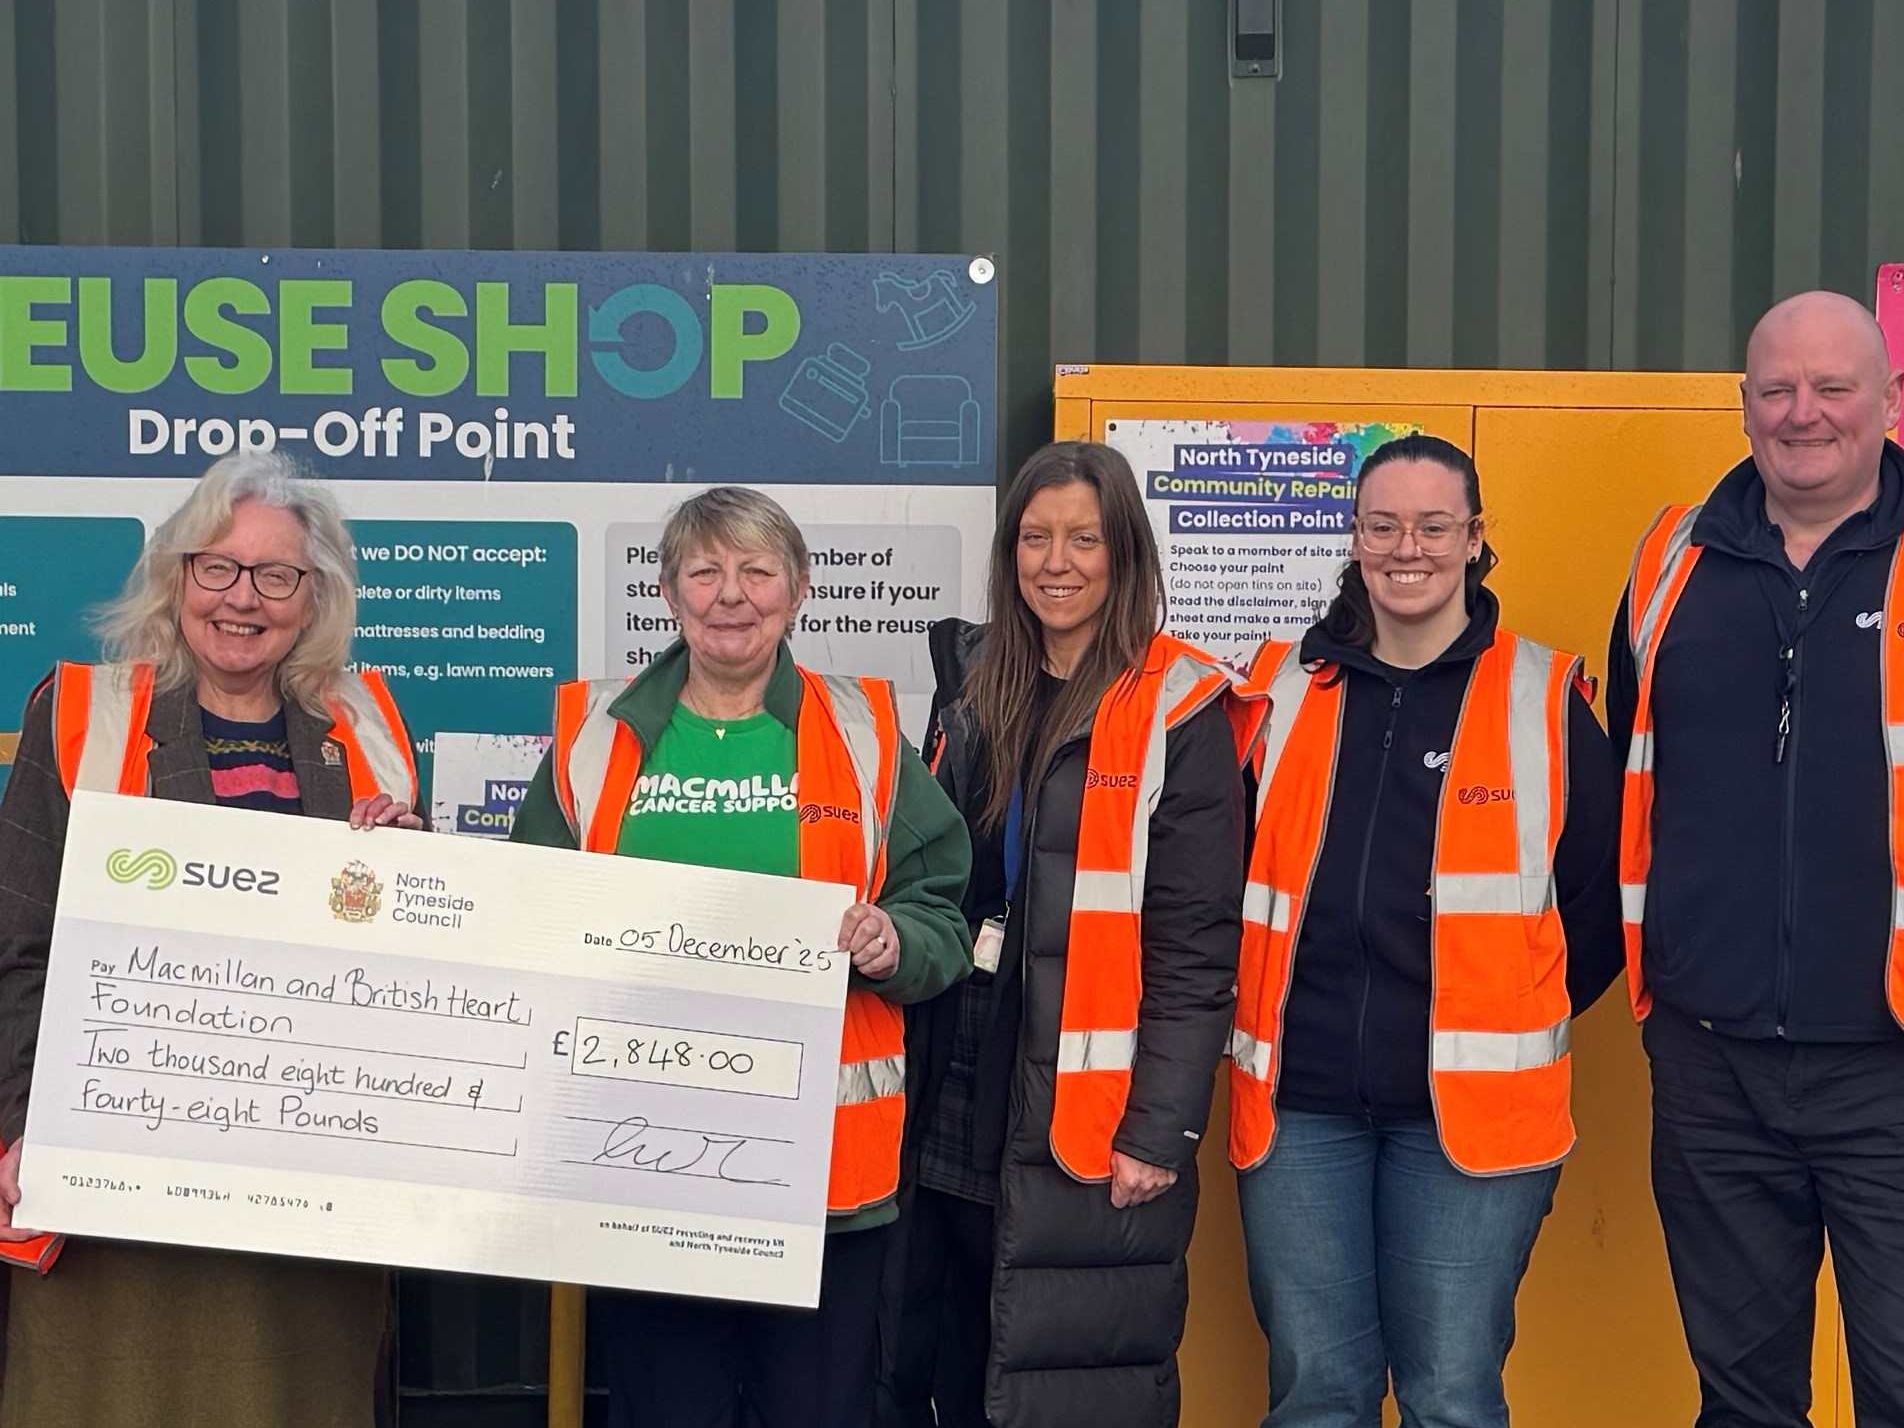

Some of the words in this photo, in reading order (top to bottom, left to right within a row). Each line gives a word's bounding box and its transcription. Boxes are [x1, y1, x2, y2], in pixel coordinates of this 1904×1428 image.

[381, 280, 802, 400] SHOP
[128, 406, 404, 457] Drop-Off
[419, 407, 575, 459] Point
[1179, 448, 1242, 466] North
[1246, 448, 1346, 471] Tyneside
[1153, 475, 1287, 502] Community
[1177, 510, 1285, 529] Collection
[1290, 511, 1345, 529] Point
[361, 547, 391, 561] we
[394, 545, 424, 561] DO
[428, 545, 469, 562] NOT
[473, 546, 548, 567] accept:
[626, 546, 660, 565] Ple
[807, 547, 867, 566] mber
[871, 547, 894, 566] of
[1170, 544, 1208, 558] Speak
[1212, 545, 1225, 556] to
[1226, 548, 1236, 556] a
[1238, 546, 1292, 558] member
[1295, 546, 1308, 558] of
[1310, 546, 1333, 558] site
[1170, 561, 1215, 572] Choose
[1220, 564, 1248, 575] your
[1251, 562, 1285, 575] paint
[395, 588, 413, 600] or
[415, 585, 451, 606] dirty
[455, 586, 502, 601] items
[626, 581, 661, 599] sta
[871, 581, 885, 600] if
[889, 584, 941, 606] your
[1194, 578, 1214, 589] not
[1217, 581, 1248, 593] open
[1252, 579, 1274, 590] tins
[1276, 582, 1293, 590] on
[1170, 595, 1202, 607] Read
[1204, 596, 1225, 607] the
[800, 614, 831, 633] for
[835, 614, 873, 633] the
[1170, 613, 1203, 624] sheet
[1206, 613, 1232, 624] and
[1234, 614, 1270, 625] make
[1273, 616, 1281, 625] a
[442, 624, 475, 640] and
[477, 624, 545, 644] bedding
[1171, 629, 1199, 641] Take
[1203, 630, 1232, 643] your
[413, 666, 443, 681] e.g.
[447, 662, 485, 678] lawn
[488, 666, 555, 679] mowers
[631, 773, 799, 801] MACMILL
[1100, 774, 1138, 788] suez
[629, 796, 717, 816] CANCER
[722, 794, 798, 814] SUPPO
[182, 861, 281, 895] suez
[396, 873, 446, 892] North
[395, 890, 475, 912] Tyneside
[392, 908, 462, 929] Council
[584, 932, 613, 947] Date
[619, 928, 662, 949] 05
[668, 923, 789, 966] December
[91, 959, 116, 975] Pay
[127, 946, 274, 992] Macmillan
[286, 974, 336, 1000] and
[345, 968, 438, 1010] British
[447, 985, 521, 1022] Heart
[91, 981, 293, 1034] Foundation
[552, 1030, 570, 1056] £
[83, 1028, 130, 1066] Two
[148, 1040, 270, 1081] thousand
[281, 1058, 345, 1095] eight
[355, 1066, 452, 1098] hundred
[280, 1095, 379, 1134] Pounds
